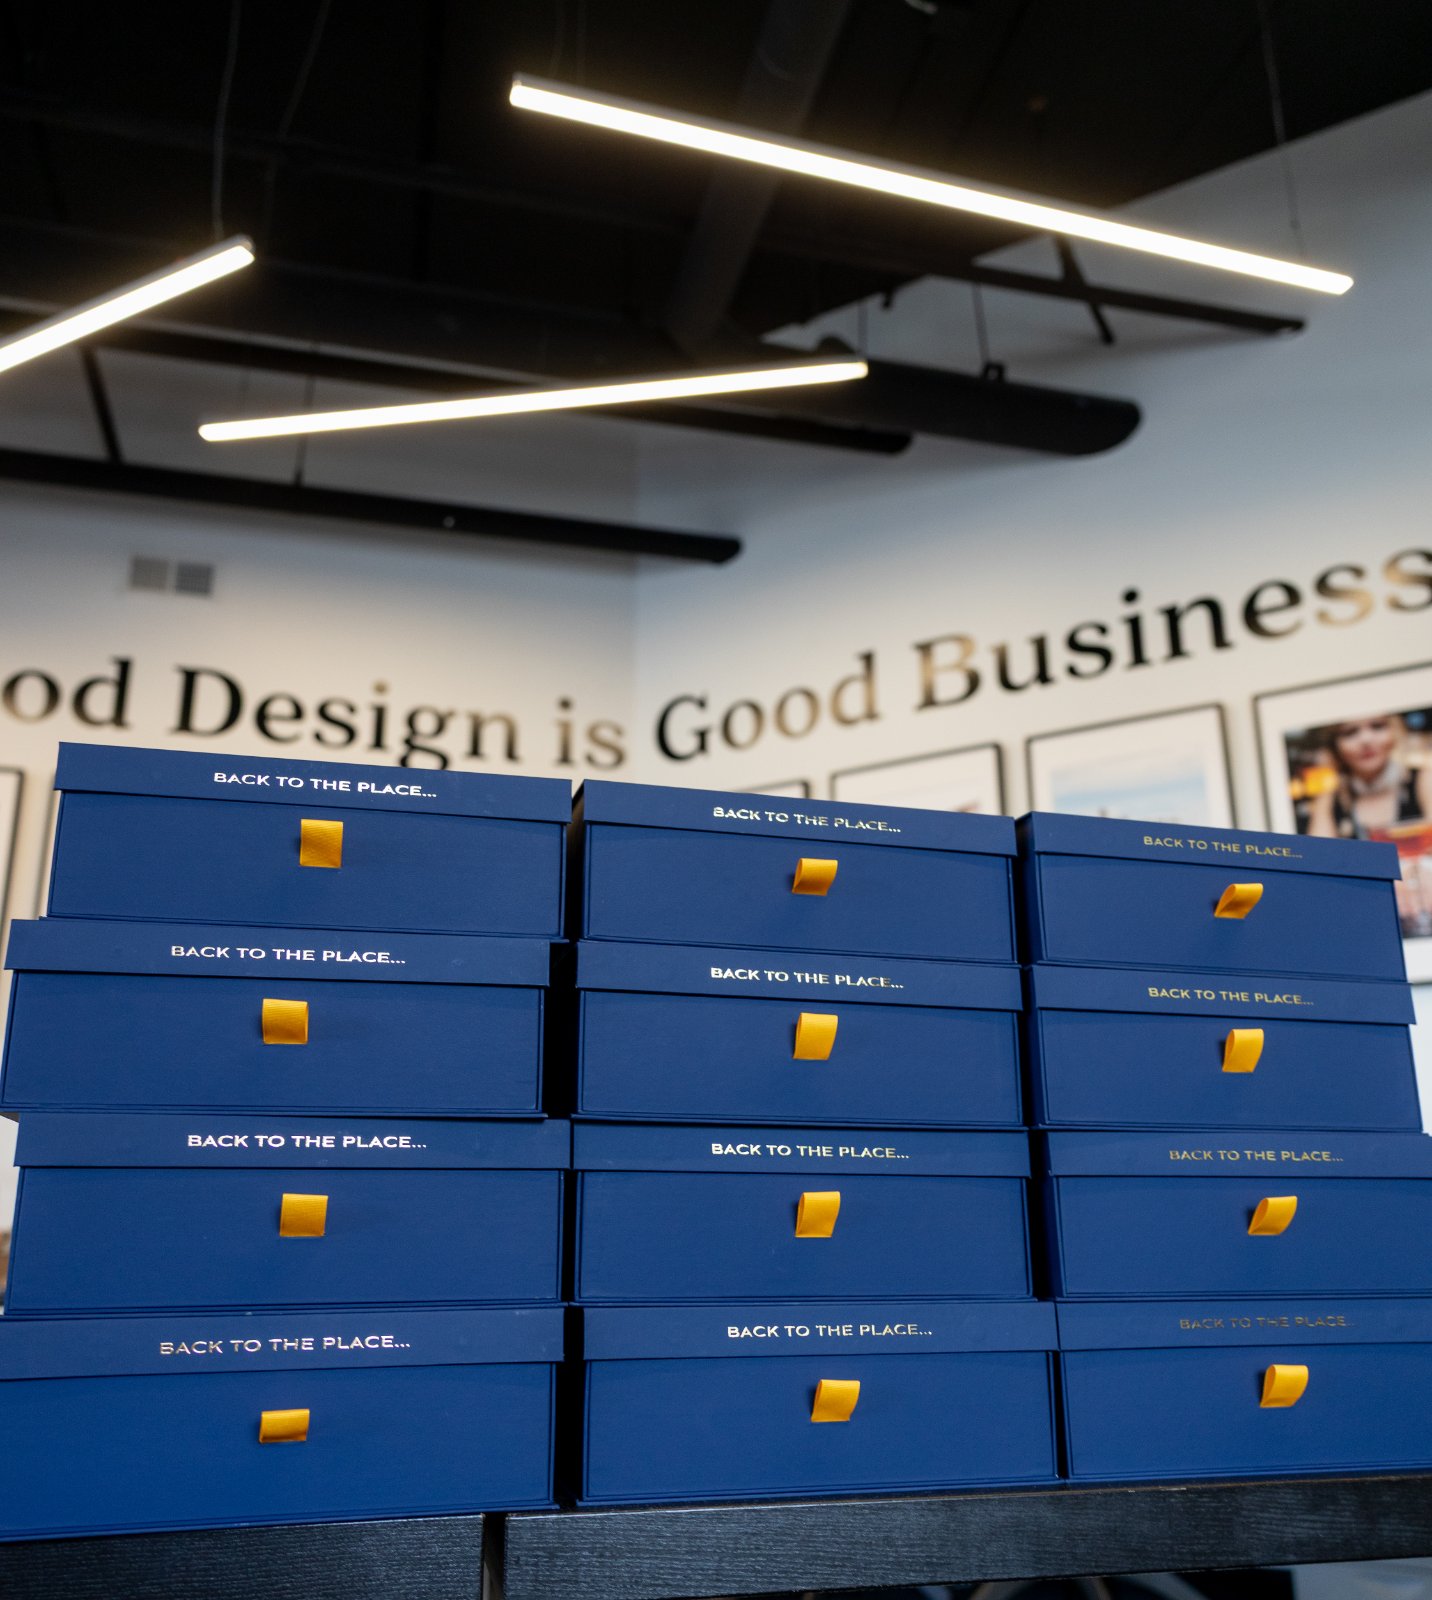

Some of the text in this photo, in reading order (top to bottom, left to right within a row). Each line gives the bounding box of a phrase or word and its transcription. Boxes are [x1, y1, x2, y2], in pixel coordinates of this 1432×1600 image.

[656, 549, 1432, 762] Good Business
[170, 664, 521, 770] Design
[555, 696, 627, 769] is
[214, 773, 270, 786] BACK
[276, 777, 304, 788] TO
[310, 779, 351, 791] THE
[713, 807, 761, 820] BACK
[765, 811, 789, 822] TO
[793, 814, 828, 826] THE
[1143, 836, 1183, 848] BACK
[1187, 839, 1208, 850] TO
[1211, 841, 1241, 853] THE
[171, 946, 230, 958] BACK
[236, 948, 266, 959] TO
[272, 949, 315, 961] THE
[711, 967, 760, 980] BACK
[764, 970, 789, 981] TO
[794, 972, 829, 984] THE
[1148, 987, 1190, 999] BACK
[1194, 990, 1215, 1000] TO
[1219, 991, 1250, 1002] THE
[188, 1135, 248, 1147] BACK
[254, 1135, 285, 1147] TO
[291, 1136, 335, 1148] THE
[712, 1143, 761, 1155] BACK
[766, 1145, 791, 1156] TO
[796, 1145, 833, 1157] THE
[1169, 1150, 1213, 1160] BACK
[1217, 1150, 1240, 1160] TO
[1243, 1150, 1276, 1161] THE
[1179, 1318, 1224, 1329] BACK
[1229, 1317, 1251, 1328] TO
[1256, 1316, 1290, 1328] THE
[728, 1326, 779, 1338] BACK
[784, 1326, 810, 1337] TO
[815, 1325, 853, 1336] THE
[160, 1341, 223, 1354] BACK
[230, 1340, 261, 1352] TO
[268, 1338, 314, 1351] THE
